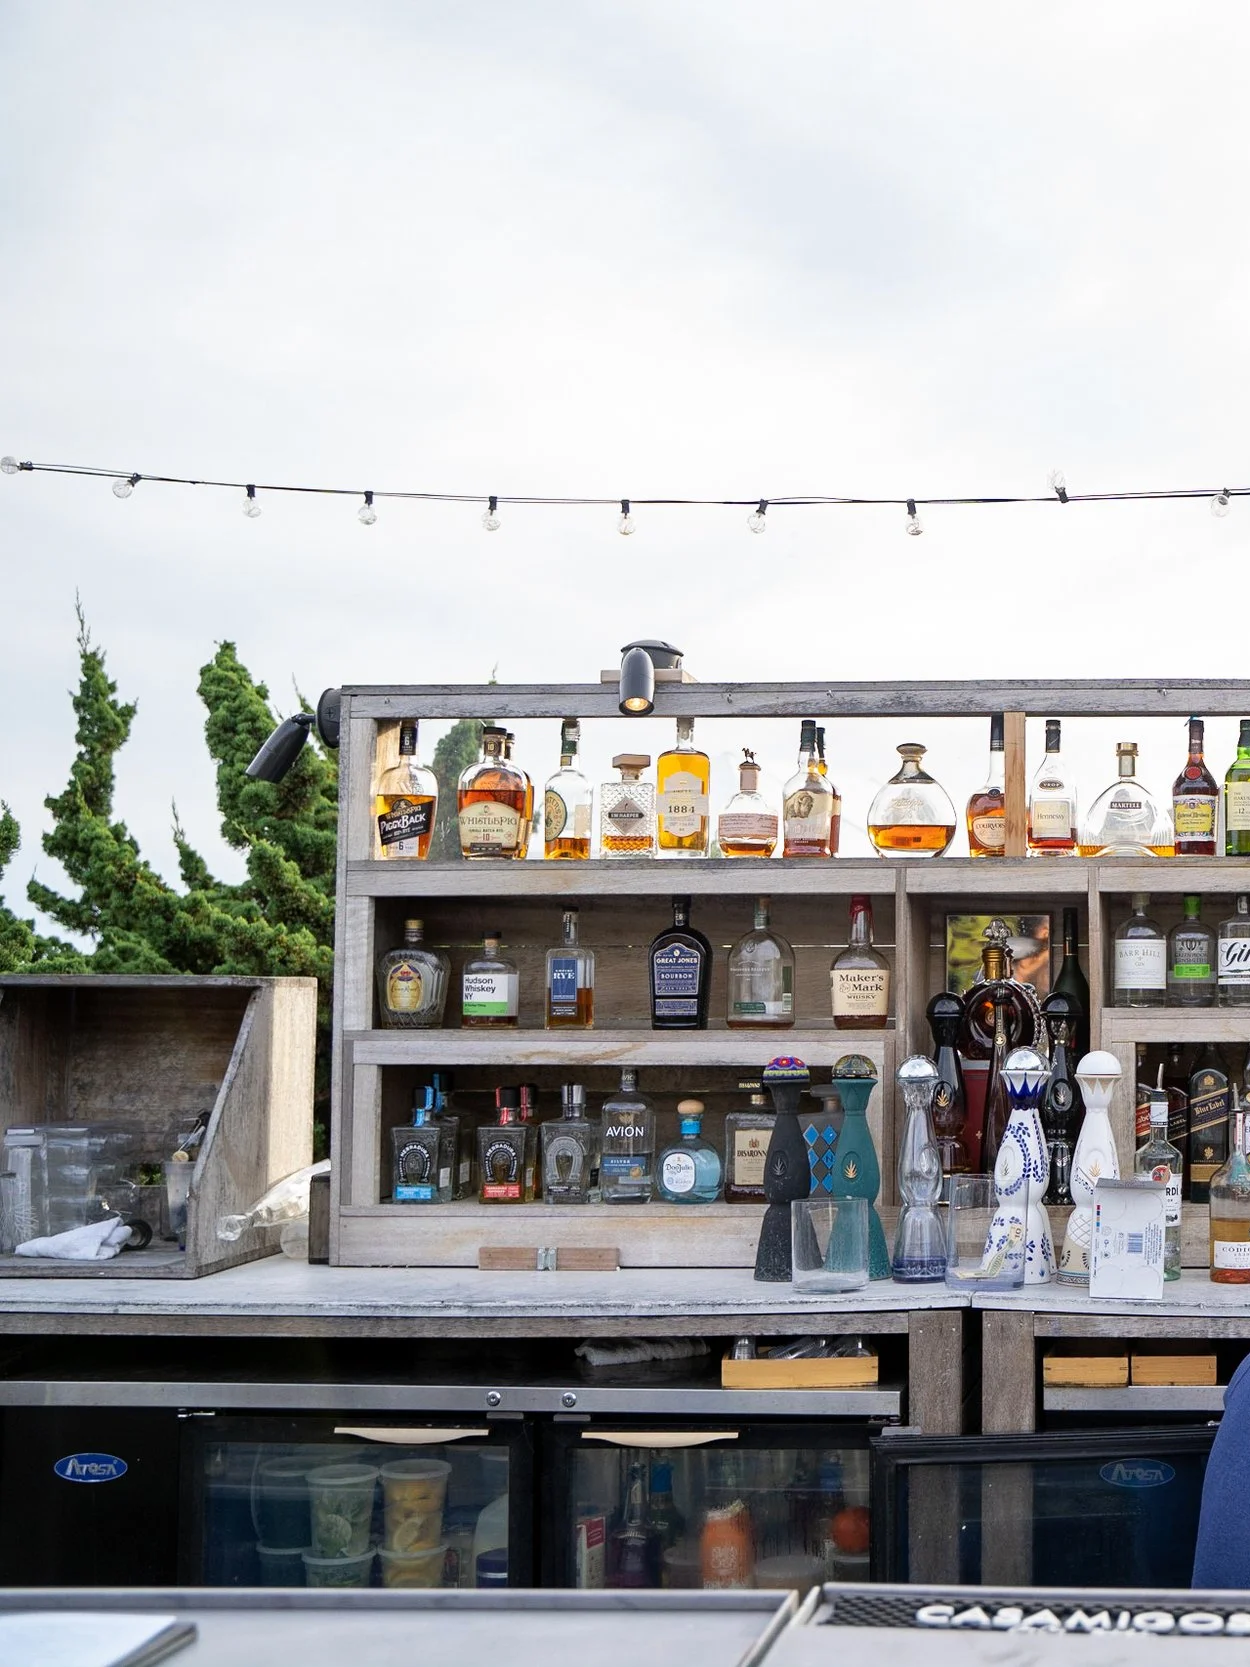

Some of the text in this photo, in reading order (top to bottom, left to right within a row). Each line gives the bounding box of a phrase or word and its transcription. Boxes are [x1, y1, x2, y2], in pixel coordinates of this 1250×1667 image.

[668, 805, 695, 813] 1884
[1037, 813, 1065, 821] Hennessy
[1119, 950, 1161, 958] BARR HILL
[465, 976, 493, 984] Hudson
[553, 972, 575, 980] RYE
[839, 973, 884, 982] Maker's
[465, 984, 496, 994] Whiskey
[851, 983, 884, 992] Mark
[1208, 1099, 1225, 1111] Label
[606, 1125, 644, 1137] AVIÓN
